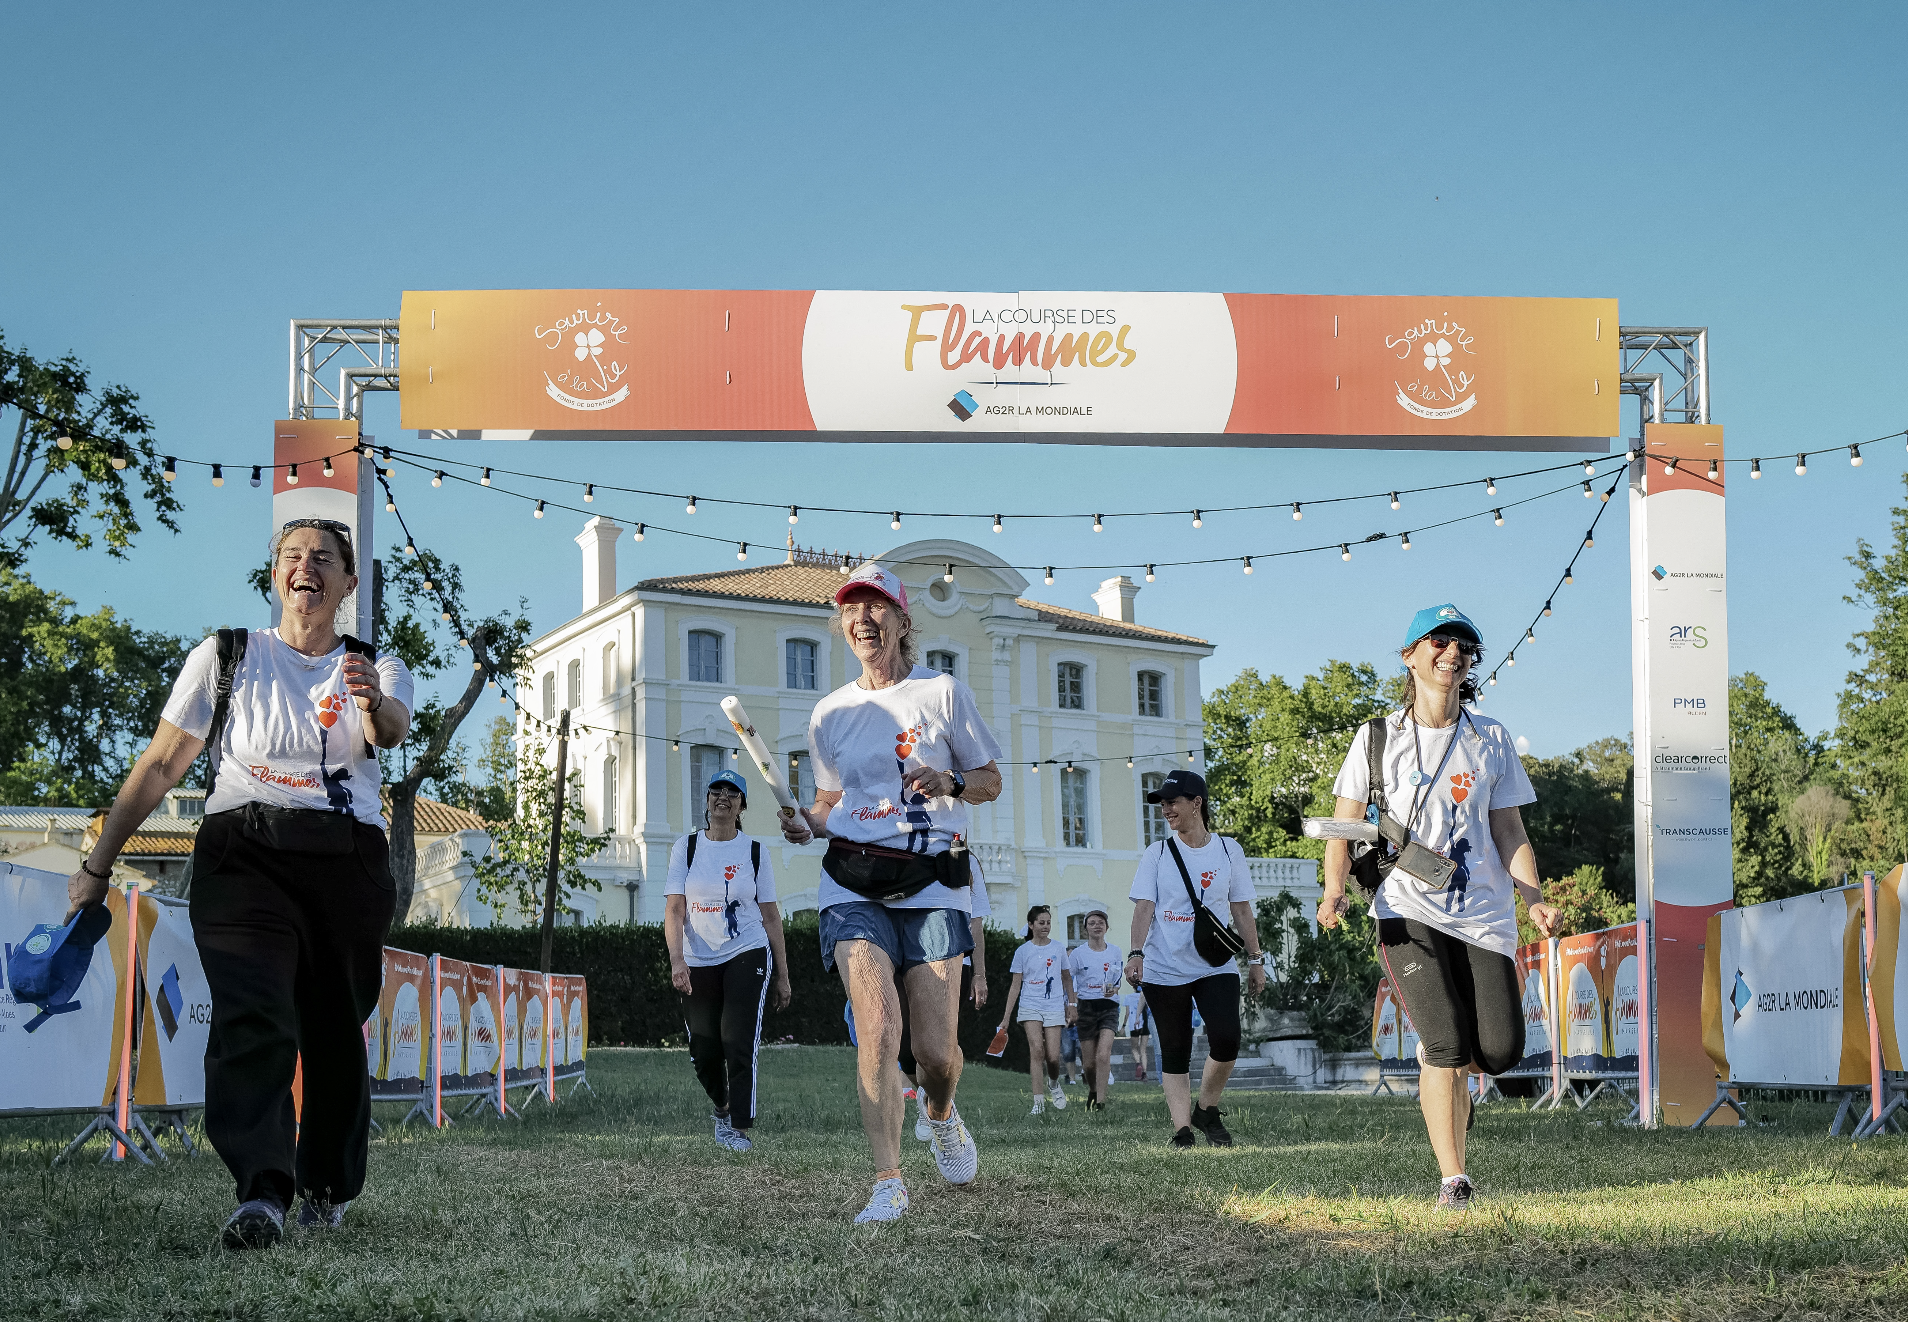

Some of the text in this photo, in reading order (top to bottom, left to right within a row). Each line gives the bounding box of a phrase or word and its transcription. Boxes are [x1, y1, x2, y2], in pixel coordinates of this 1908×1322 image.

[535, 302, 630, 350] Sourire
[973, 309, 1117, 324] LA COURSE DES
[901, 303, 1137, 371] Flammes
[1385, 311, 1477, 359] Sourire
[590, 356, 628, 392] Vie
[1438, 366, 1475, 401] Vie
[985, 406, 1093, 416] AG2R LA MONDIALE
[1673, 697, 1707, 709] PMB
[1654, 753, 1728, 765] clearcorrect
[249, 765, 320, 788] Flammes
[1659, 828, 1729, 836] TRANSCAUSSE
[1757, 988, 1839, 1012] AG2R LA MONDIALE
